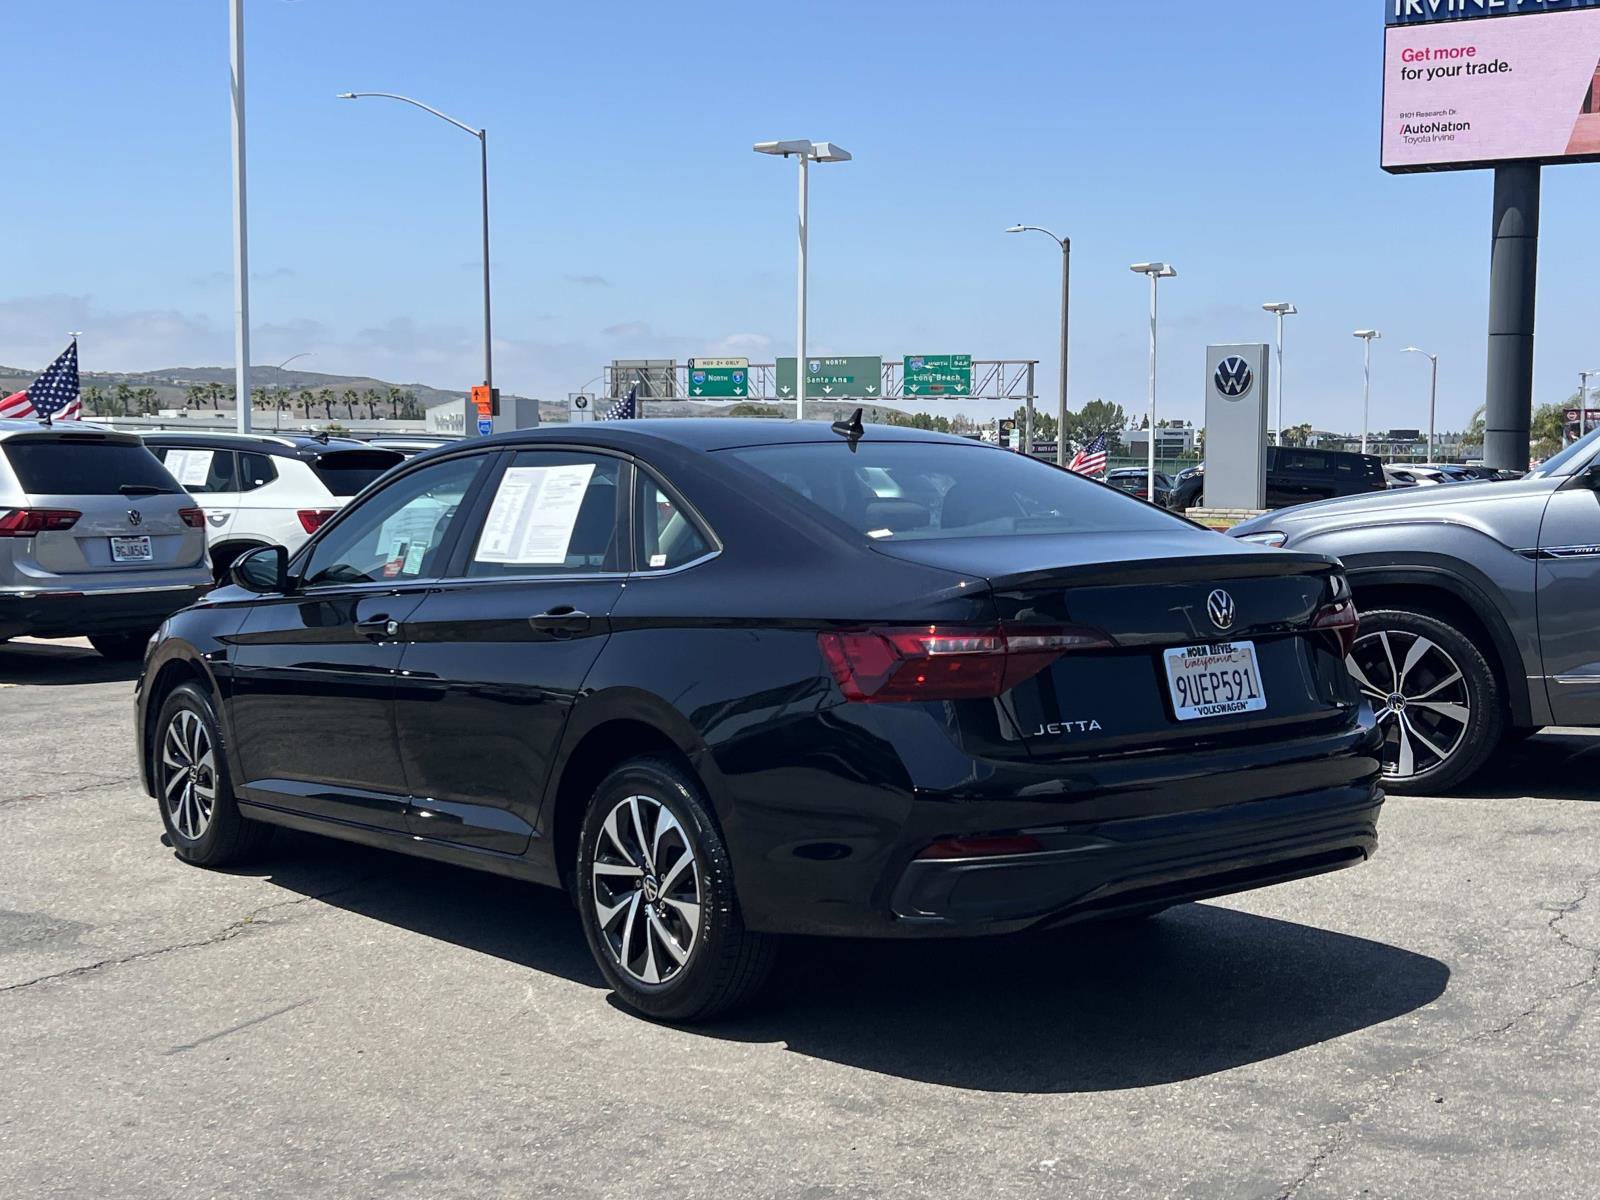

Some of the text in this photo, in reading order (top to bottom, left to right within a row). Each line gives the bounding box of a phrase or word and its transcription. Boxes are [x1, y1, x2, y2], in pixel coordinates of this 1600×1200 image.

[1401, 46, 1476, 63] Get more
[1401, 59, 1513, 81] for your trade.
[1416, 110, 1447, 118] Research
[1404, 134, 1455, 145] Toyota Irvine
[806, 376, 829, 384] Santa
[913, 373, 961, 383] Long Beach
[1186, 645, 1208, 658] NORM
[1176, 668, 1257, 707] 9UEP591
[1033, 719, 1103, 736] JETTA
